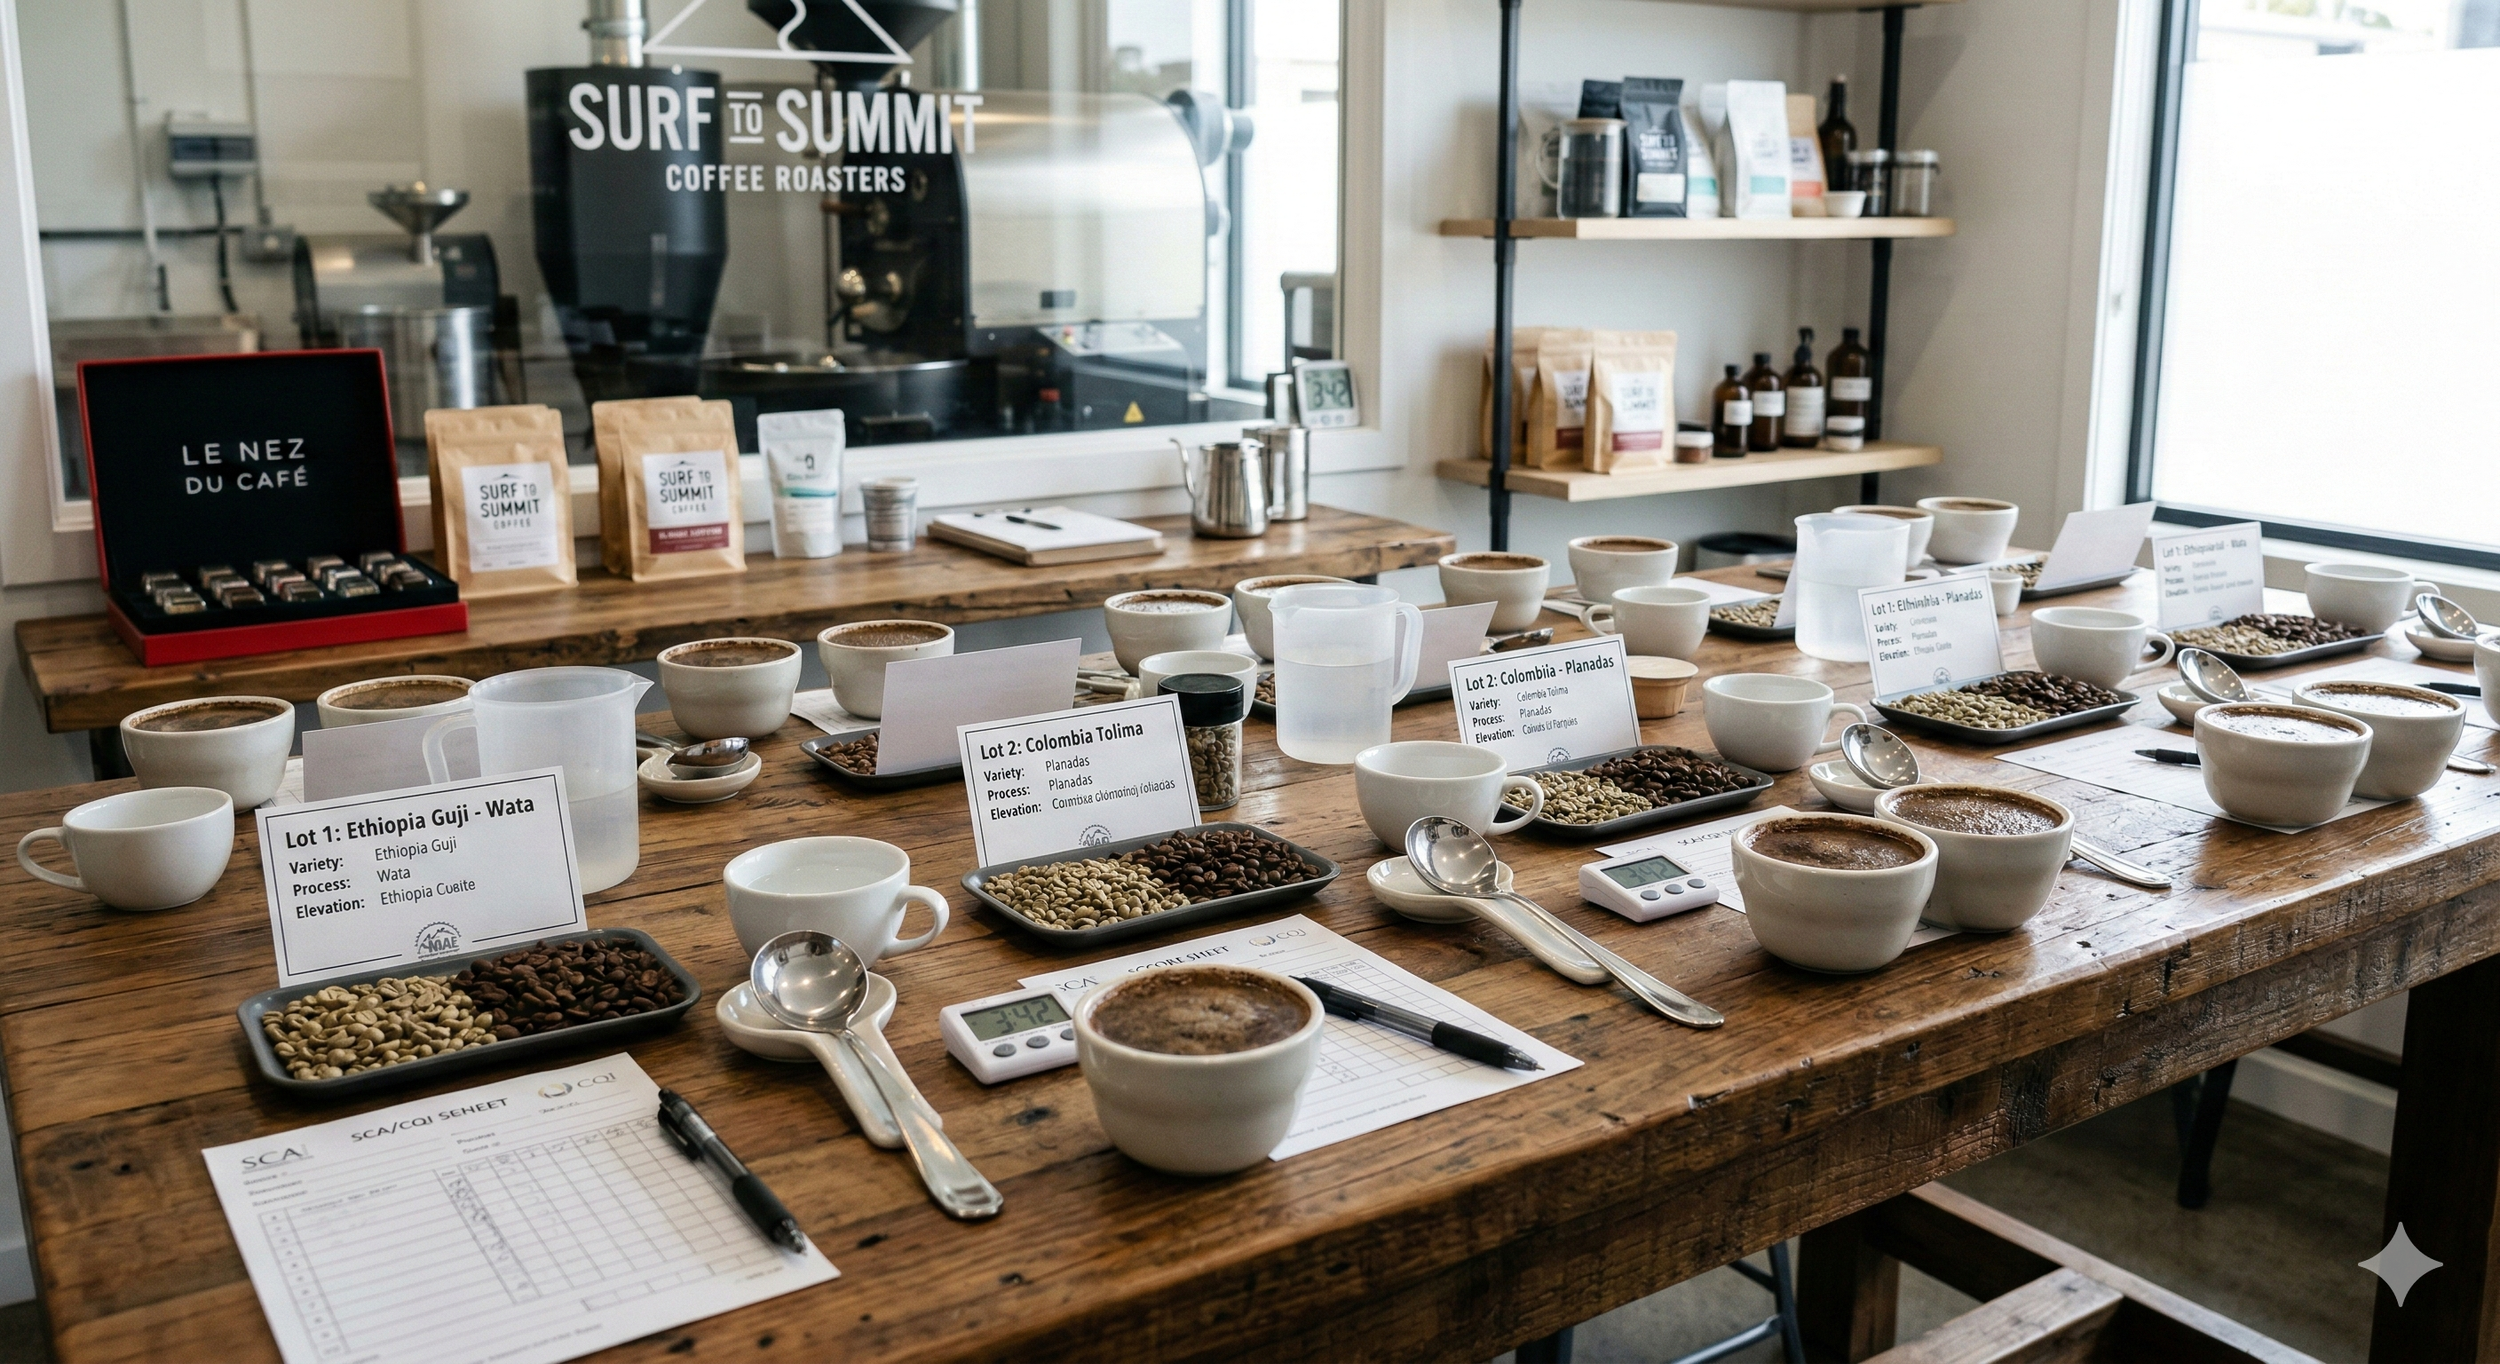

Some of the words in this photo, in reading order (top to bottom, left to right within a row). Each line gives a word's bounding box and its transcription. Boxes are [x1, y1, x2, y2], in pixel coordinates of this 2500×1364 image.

[569, 82, 716, 151] SURF
[729, 102, 763, 135] TO
[776, 89, 984, 154] SUMMIT
[666, 164, 764, 192] COFFEE
[775, 165, 906, 193] ROASTERS
[183, 443, 222, 466] LE
[240, 438, 306, 462] NEZ
[186, 475, 223, 494] DU
[237, 465, 309, 491] CAFÉ
[480, 483, 518, 500] SURF
[659, 470, 694, 487] SURF
[660, 485, 714, 503] SUMMIT
[480, 498, 540, 518] SUMMIT
[1871, 603, 1886, 615] Lot
[1465, 676, 1485, 692] Lot
[1486, 674, 1498, 688] 2:
[1565, 655, 1615, 675] Planadas
[1469, 698, 1501, 711] Variety:
[1472, 714, 1505, 728] Process:
[1520, 705, 1552, 718] Planadas
[980, 744, 1005, 760] Lot
[1007, 740, 1022, 756] 2:
[1025, 728, 1094, 753] Colombia
[1095, 722, 1144, 742] Tolima
[1475, 729, 1515, 744] Elevation:
[984, 767, 1025, 783] Variety:
[1045, 755, 1091, 773] Planadas
[987, 785, 1031, 801] Process:
[1048, 774, 1093, 791] Planadas
[286, 828, 318, 849] Lot
[321, 825, 342, 843] 1:
[346, 811, 426, 840] Ethiopia
[431, 805, 469, 829] Guji
[486, 796, 535, 818] Wata
[990, 802, 1042, 820] Elevation:
[289, 857, 344, 875] Variety:
[374, 842, 429, 862] Ethiopia
[431, 836, 458, 854] Guji
[293, 877, 352, 897] Process:
[376, 866, 411, 883] Wata
[295, 897, 366, 919] Elevation:
[380, 886, 434, 906] Ethiopia
[1186, 945, 1230, 963] SHEET
[990, 1000, 1054, 1034] 3:42
[577, 1072, 618, 1088] CQI
[351, 1115, 435, 1143] SCA/CQI
[242, 1147, 303, 1171] SCA
